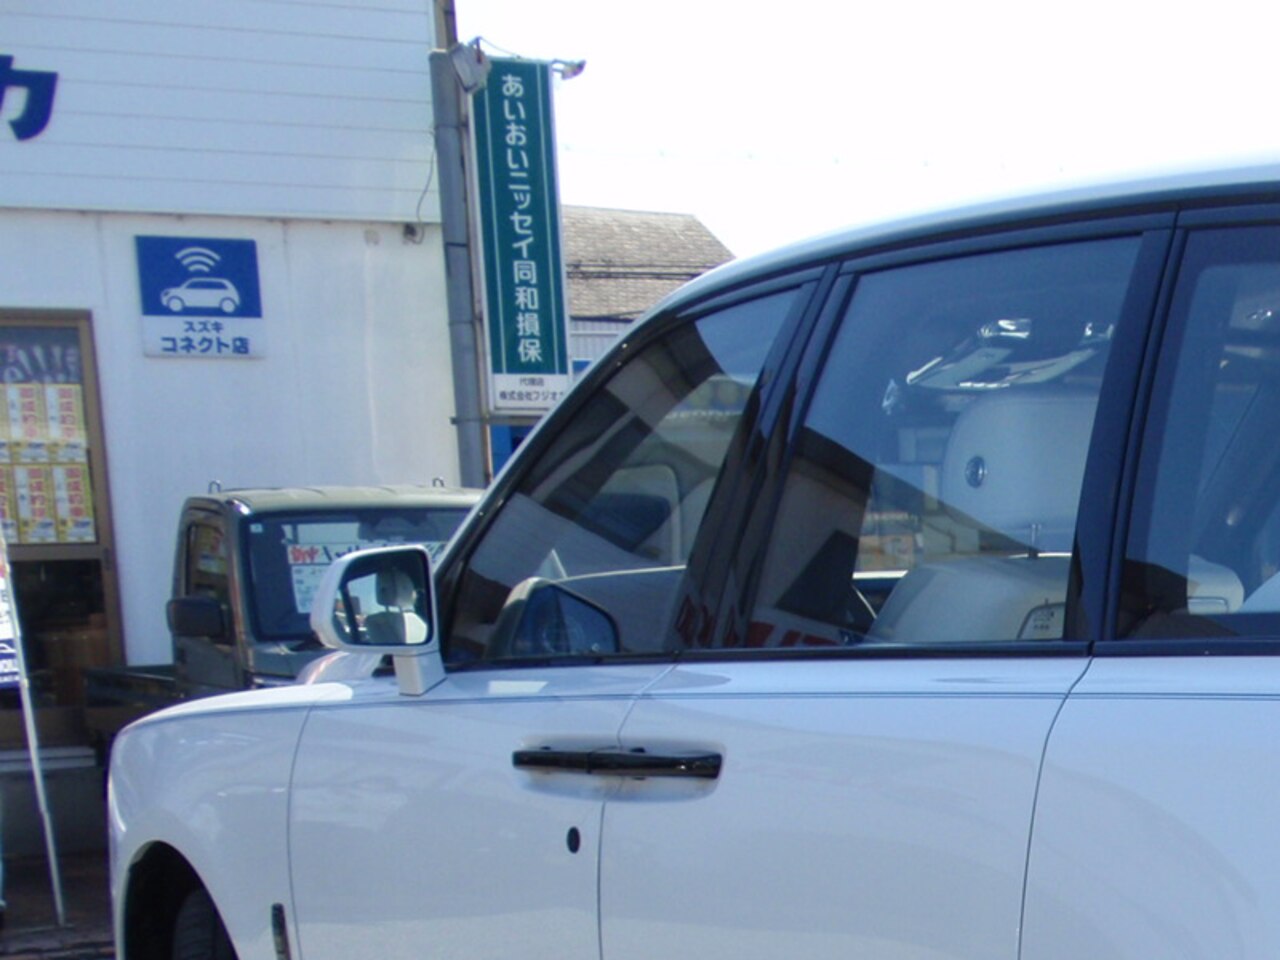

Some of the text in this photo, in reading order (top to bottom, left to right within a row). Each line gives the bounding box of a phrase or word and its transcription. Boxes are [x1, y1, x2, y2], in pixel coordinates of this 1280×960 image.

[501, 74, 543, 363] あいおいニッセイ同和損保
[184, 321, 223, 333] スズキ
[161, 336, 249, 354] コネクト店
